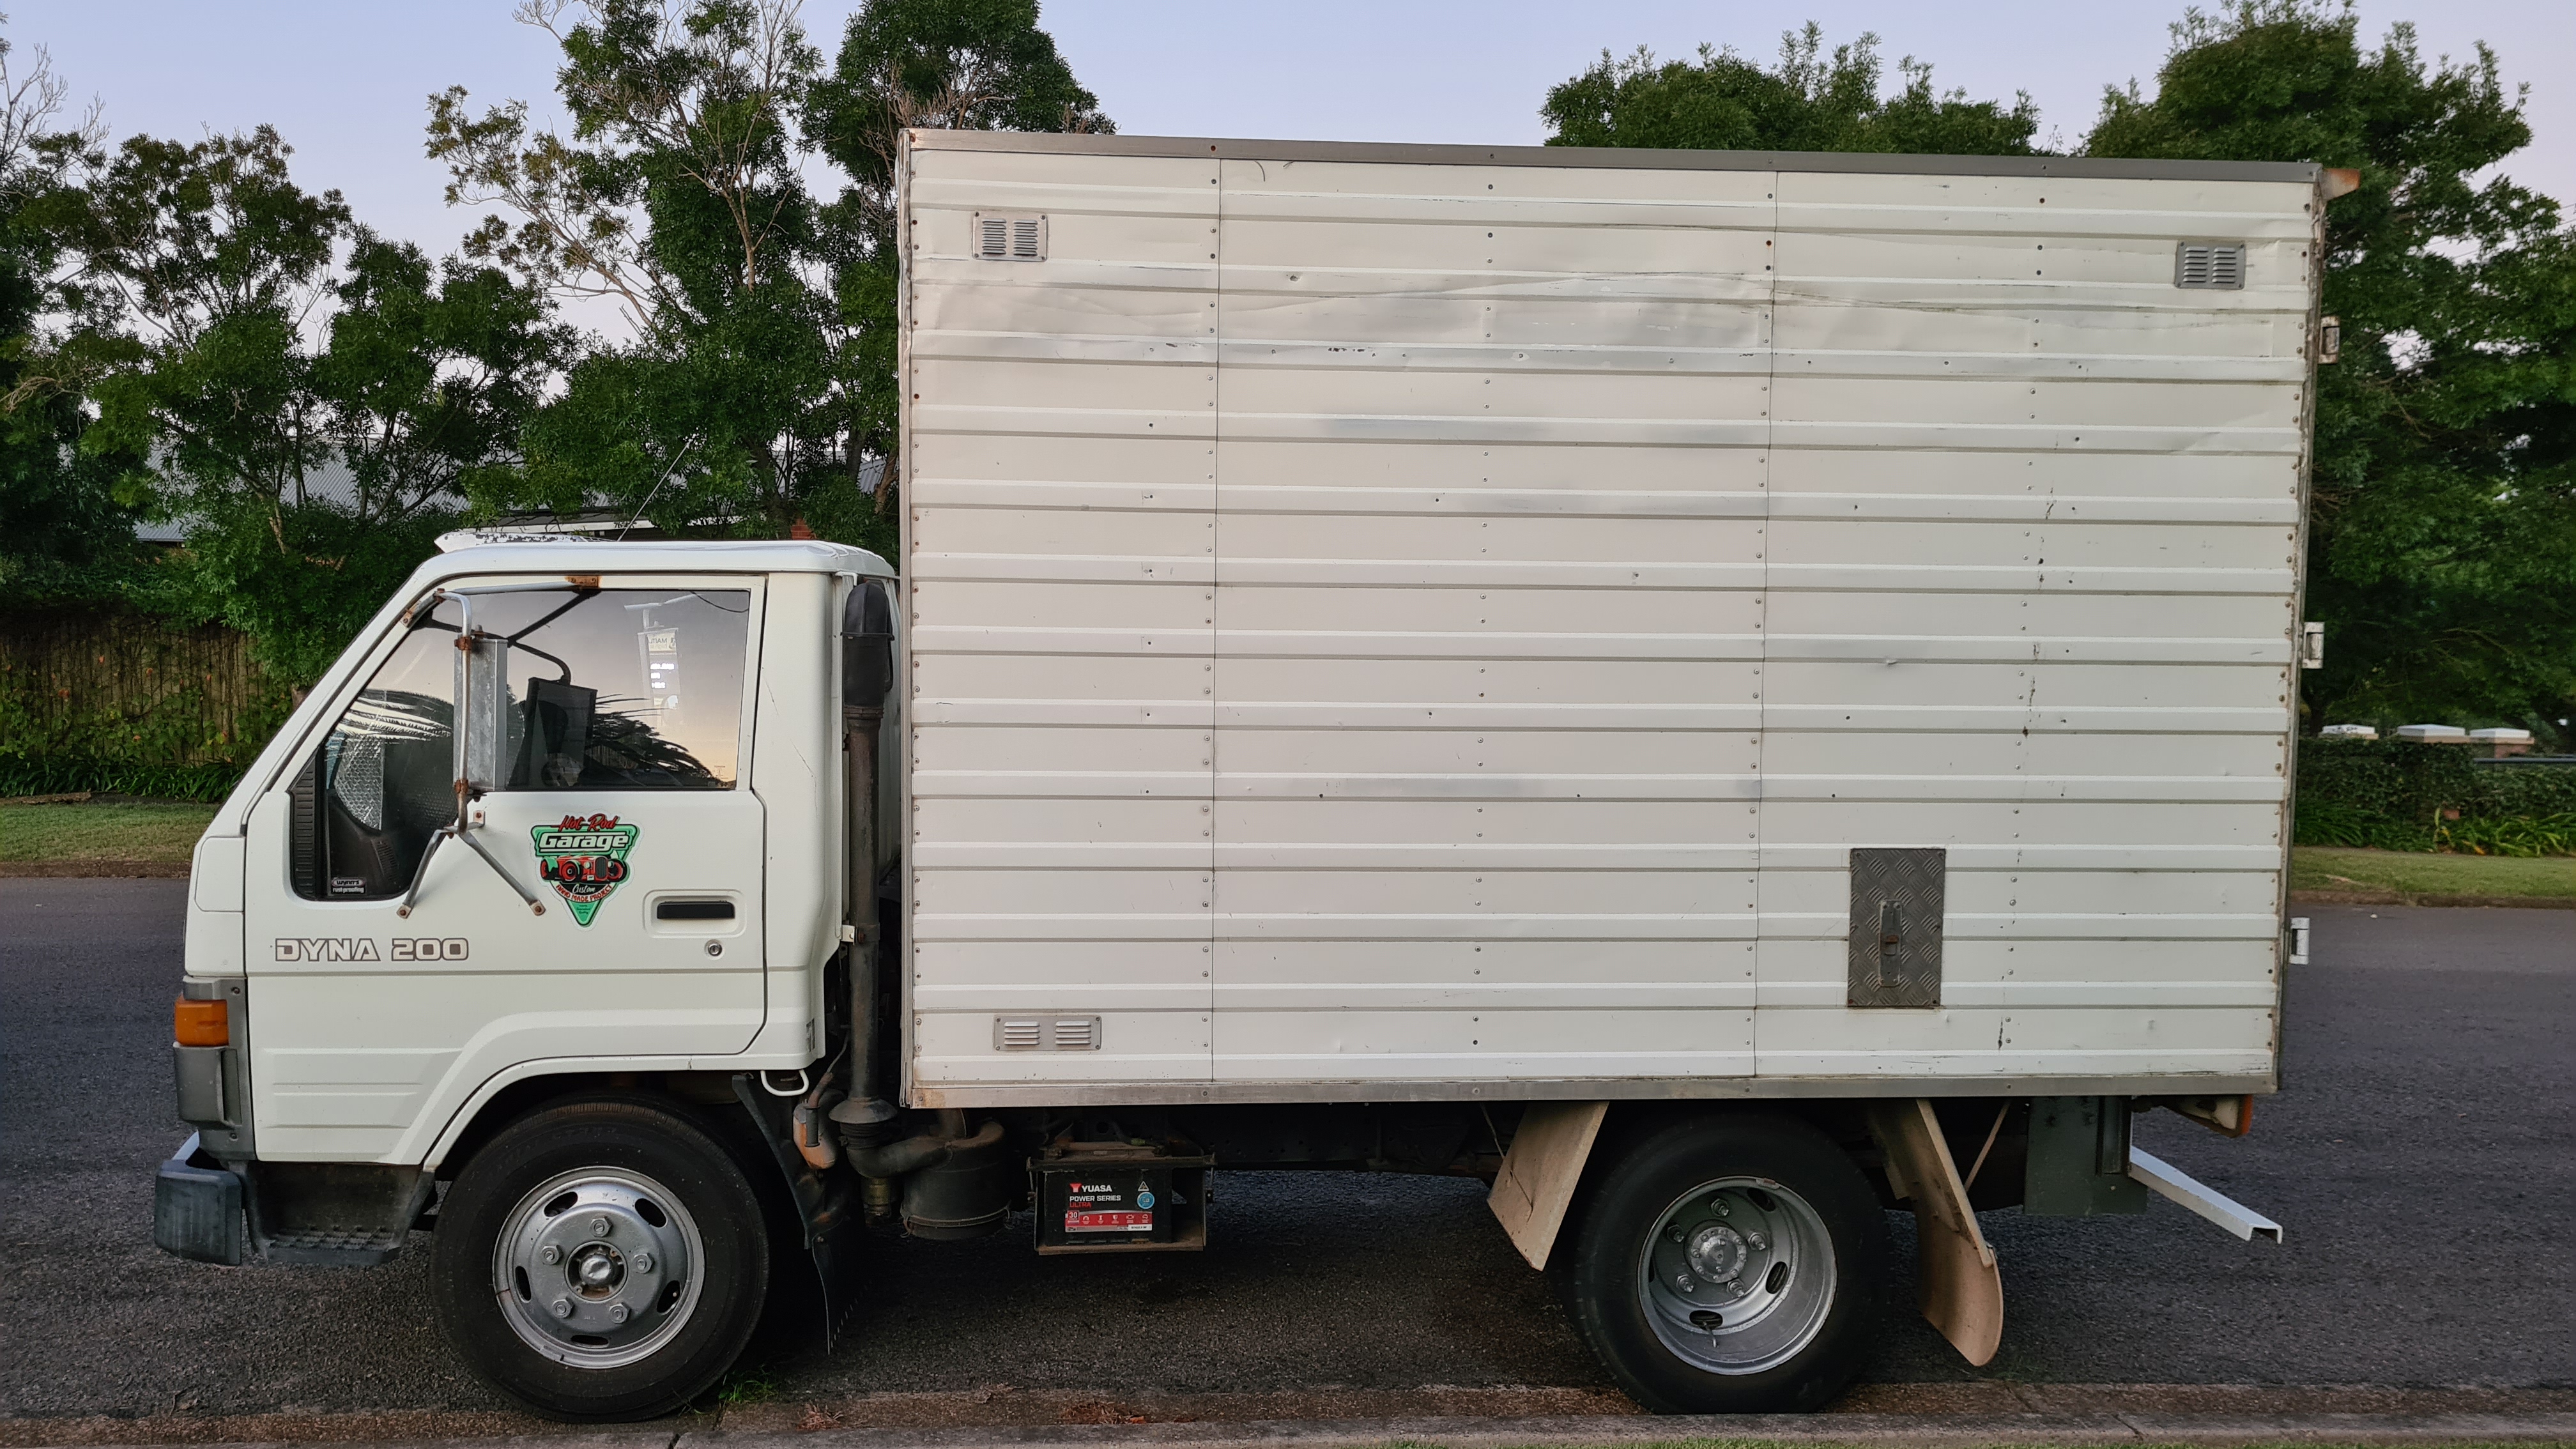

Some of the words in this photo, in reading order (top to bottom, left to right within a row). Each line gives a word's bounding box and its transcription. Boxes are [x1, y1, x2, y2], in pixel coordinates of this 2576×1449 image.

[556, 815, 586, 832] Hot
[587, 813, 618, 832] Rod
[539, 832, 629, 852] Garage
[571, 894, 588, 902] MADE
[590, 884, 612, 901] PROJECT
[572, 884, 595, 894] Custom
[275, 938, 381, 962] DYNA
[391, 937, 469, 962] 200
[1082, 1184, 1112, 1193] YUASA
